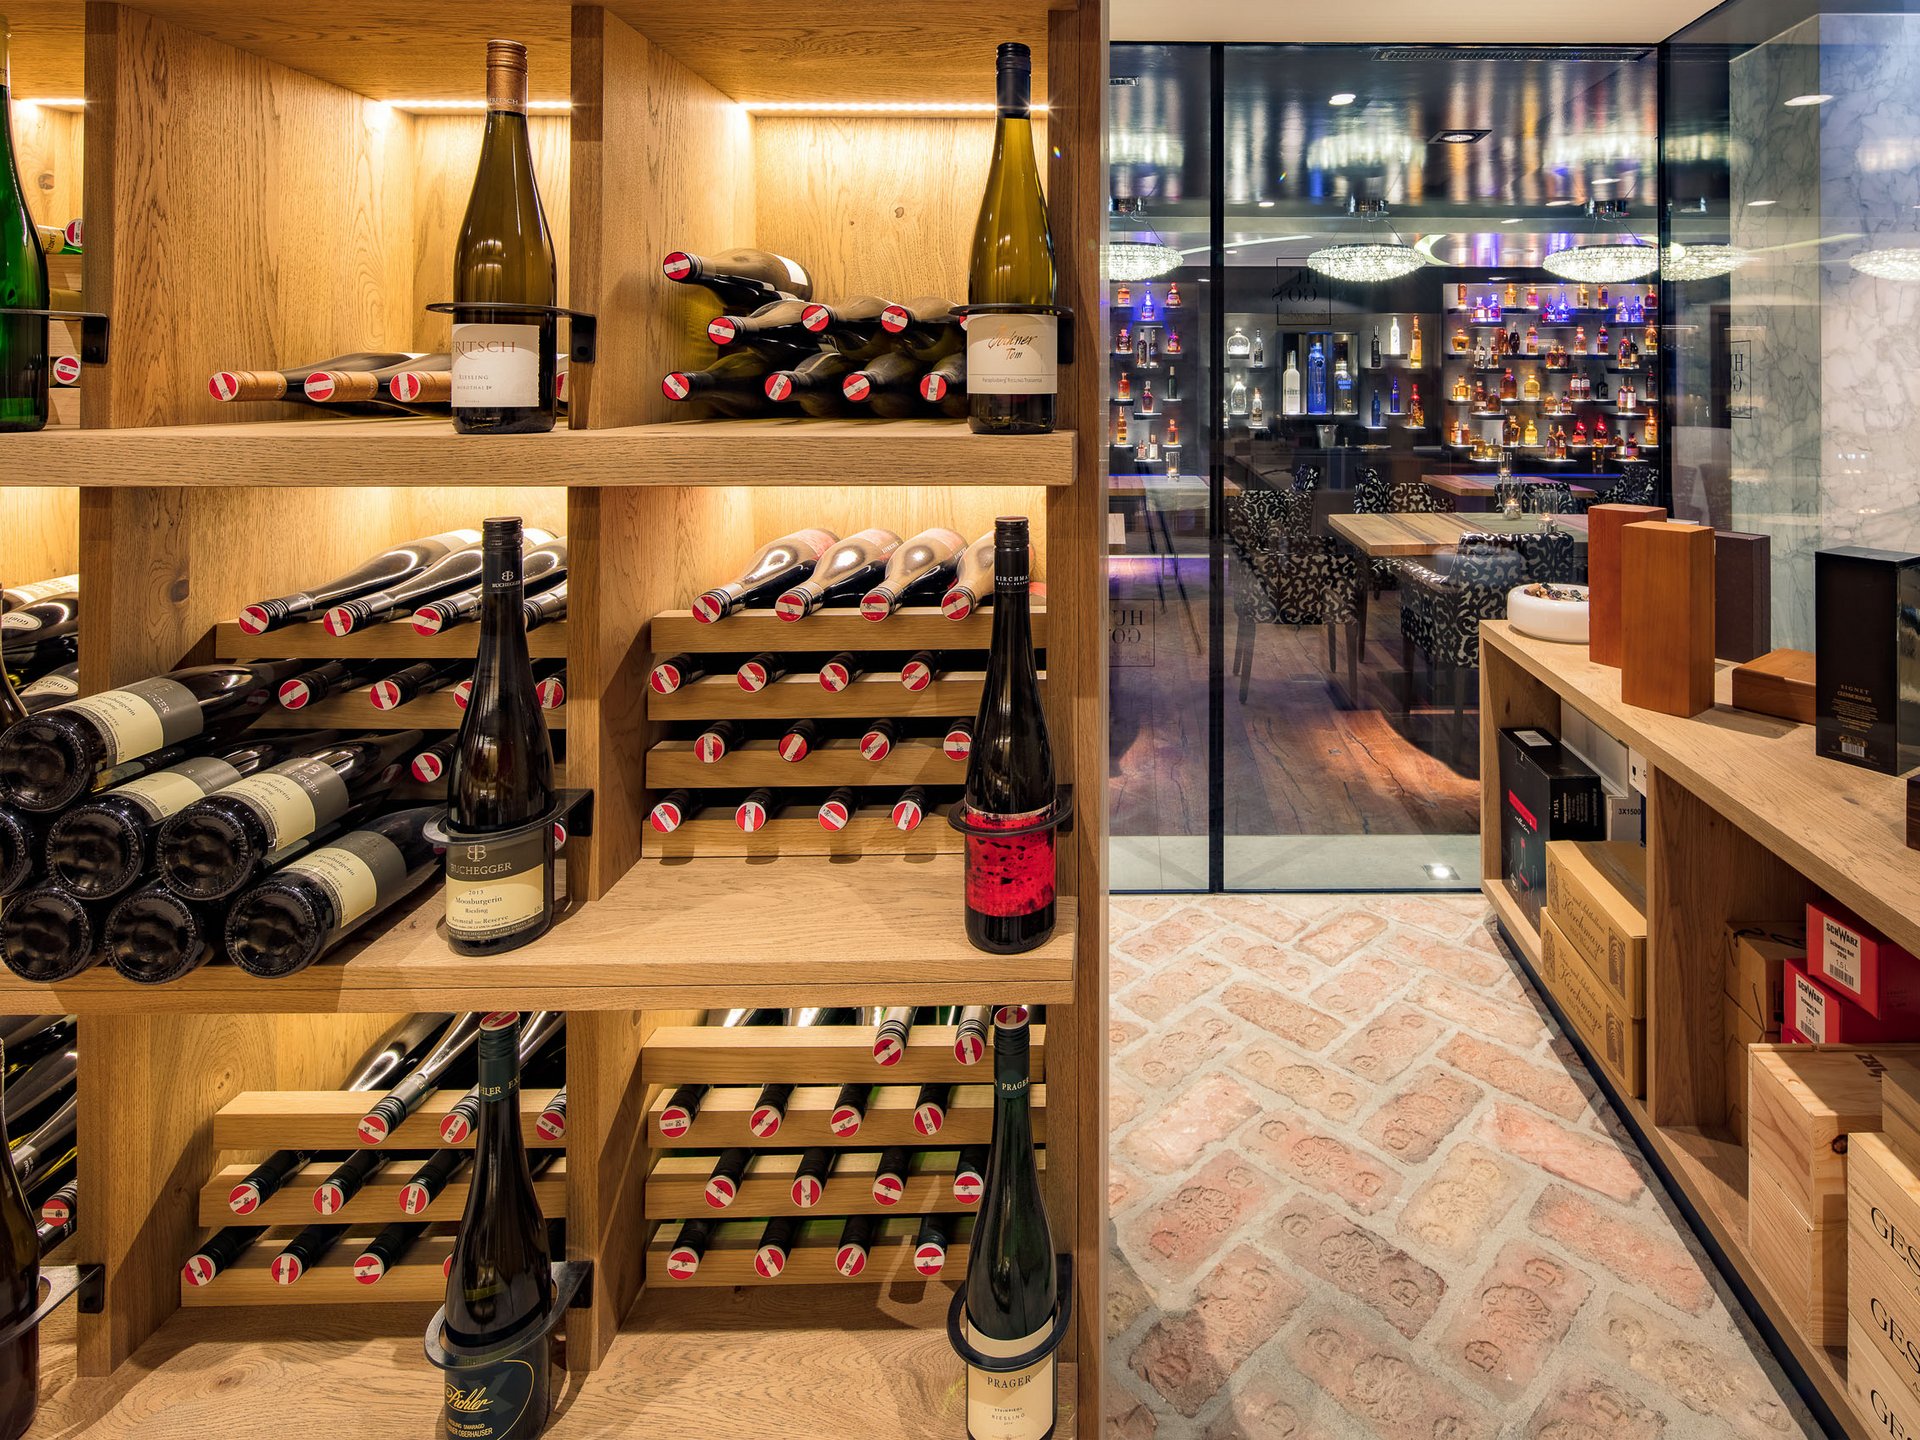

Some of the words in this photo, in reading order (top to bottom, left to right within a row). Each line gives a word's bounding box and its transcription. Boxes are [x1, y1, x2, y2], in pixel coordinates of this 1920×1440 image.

[453, 340, 516, 360] RITSCH
[1006, 348, 1023, 360] Tom
[450, 862, 512, 875] BUCHEGGER
[1826, 922, 1858, 948] SCHWARZ
[1871, 1298, 1920, 1375] GES
[987, 1374, 1032, 1389] PRAGER
[446, 1386, 494, 1411] Pichler
[1871, 1390, 1912, 1440] GE
[458, 1427, 493, 1438] OBERHAUSER
